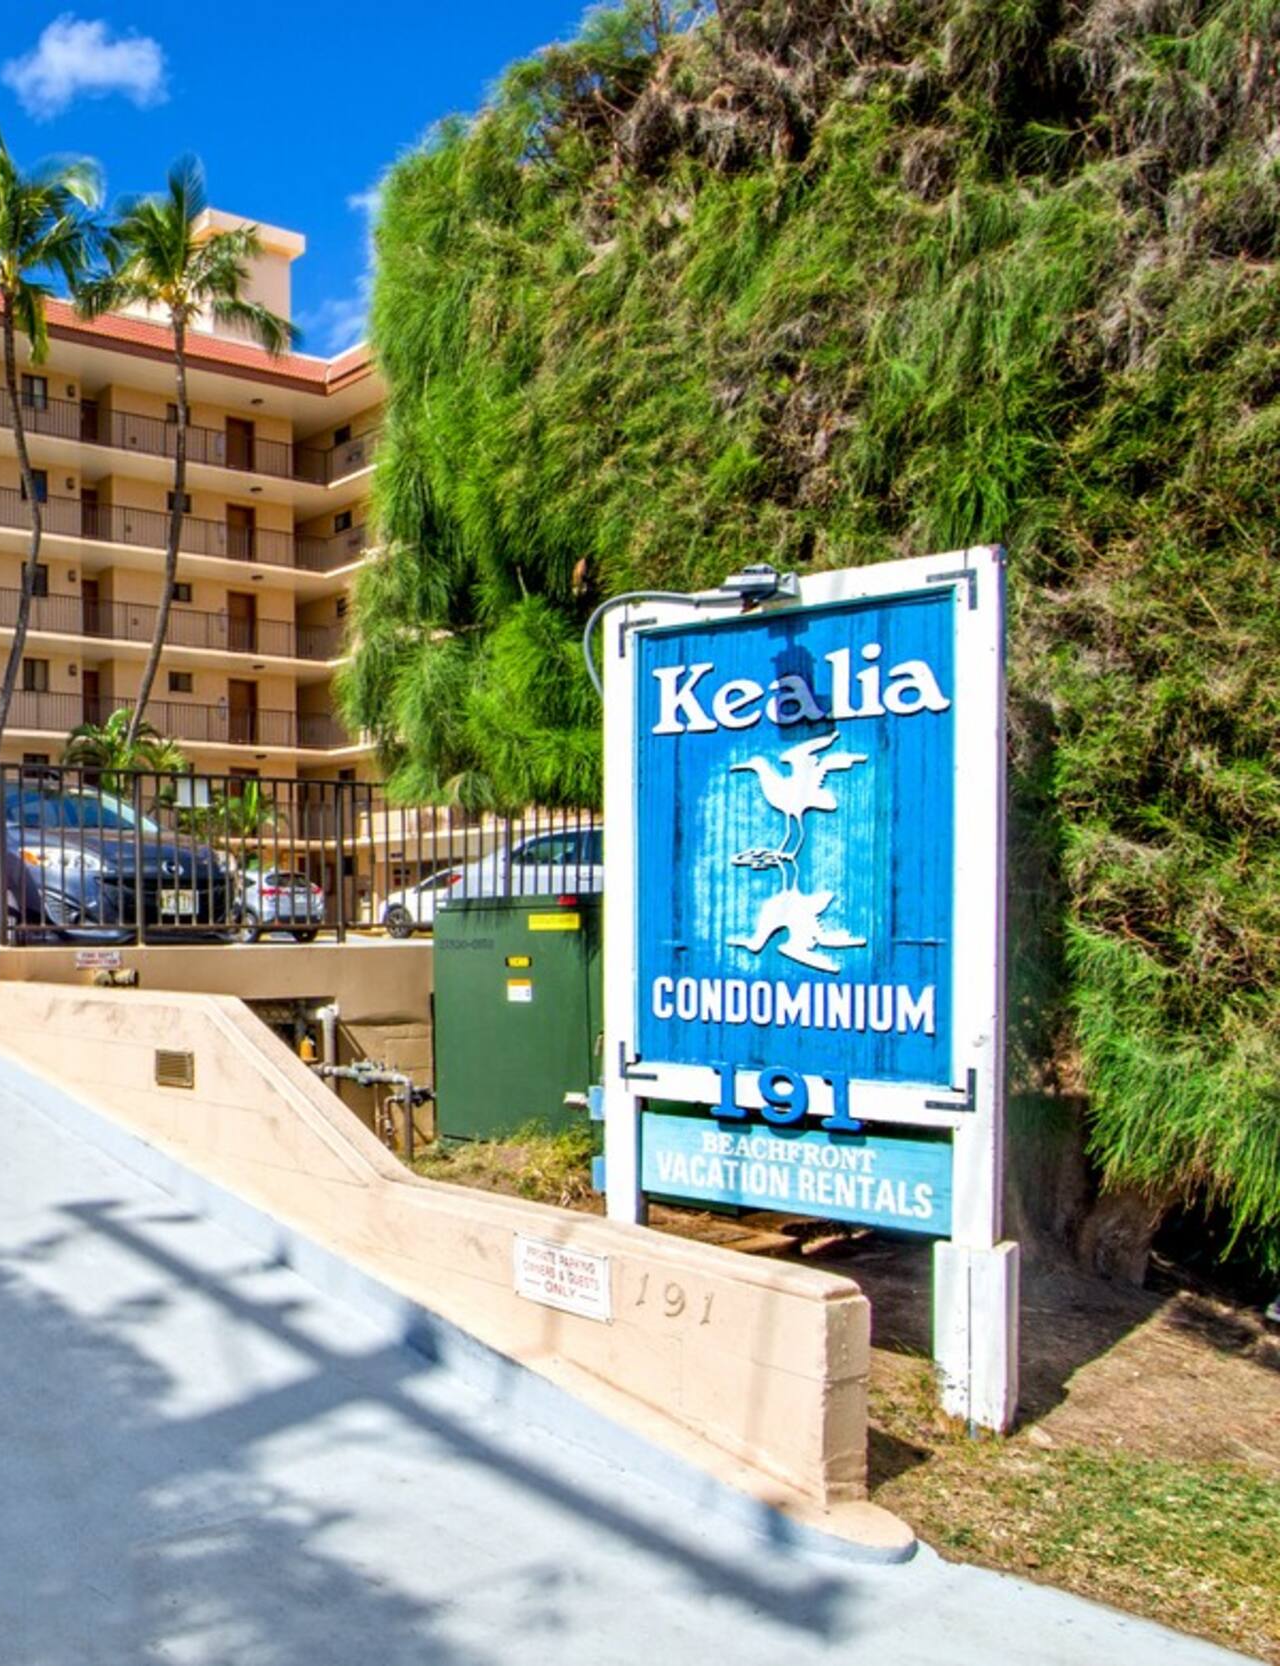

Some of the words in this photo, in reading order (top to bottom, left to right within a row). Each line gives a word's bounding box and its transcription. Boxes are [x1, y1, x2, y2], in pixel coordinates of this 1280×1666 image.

[652, 643, 950, 735] Kealia
[652, 976, 936, 1035] CONDOMINIUM
[710, 1062, 862, 1133] 191
[701, 1130, 878, 1174] BEACHFRONT
[656, 1151, 790, 1198] VACATION
[798, 1166, 934, 1219] RENTALS
[544, 1280, 577, 1298] ONLY
[635, 1273, 715, 1326] 191
